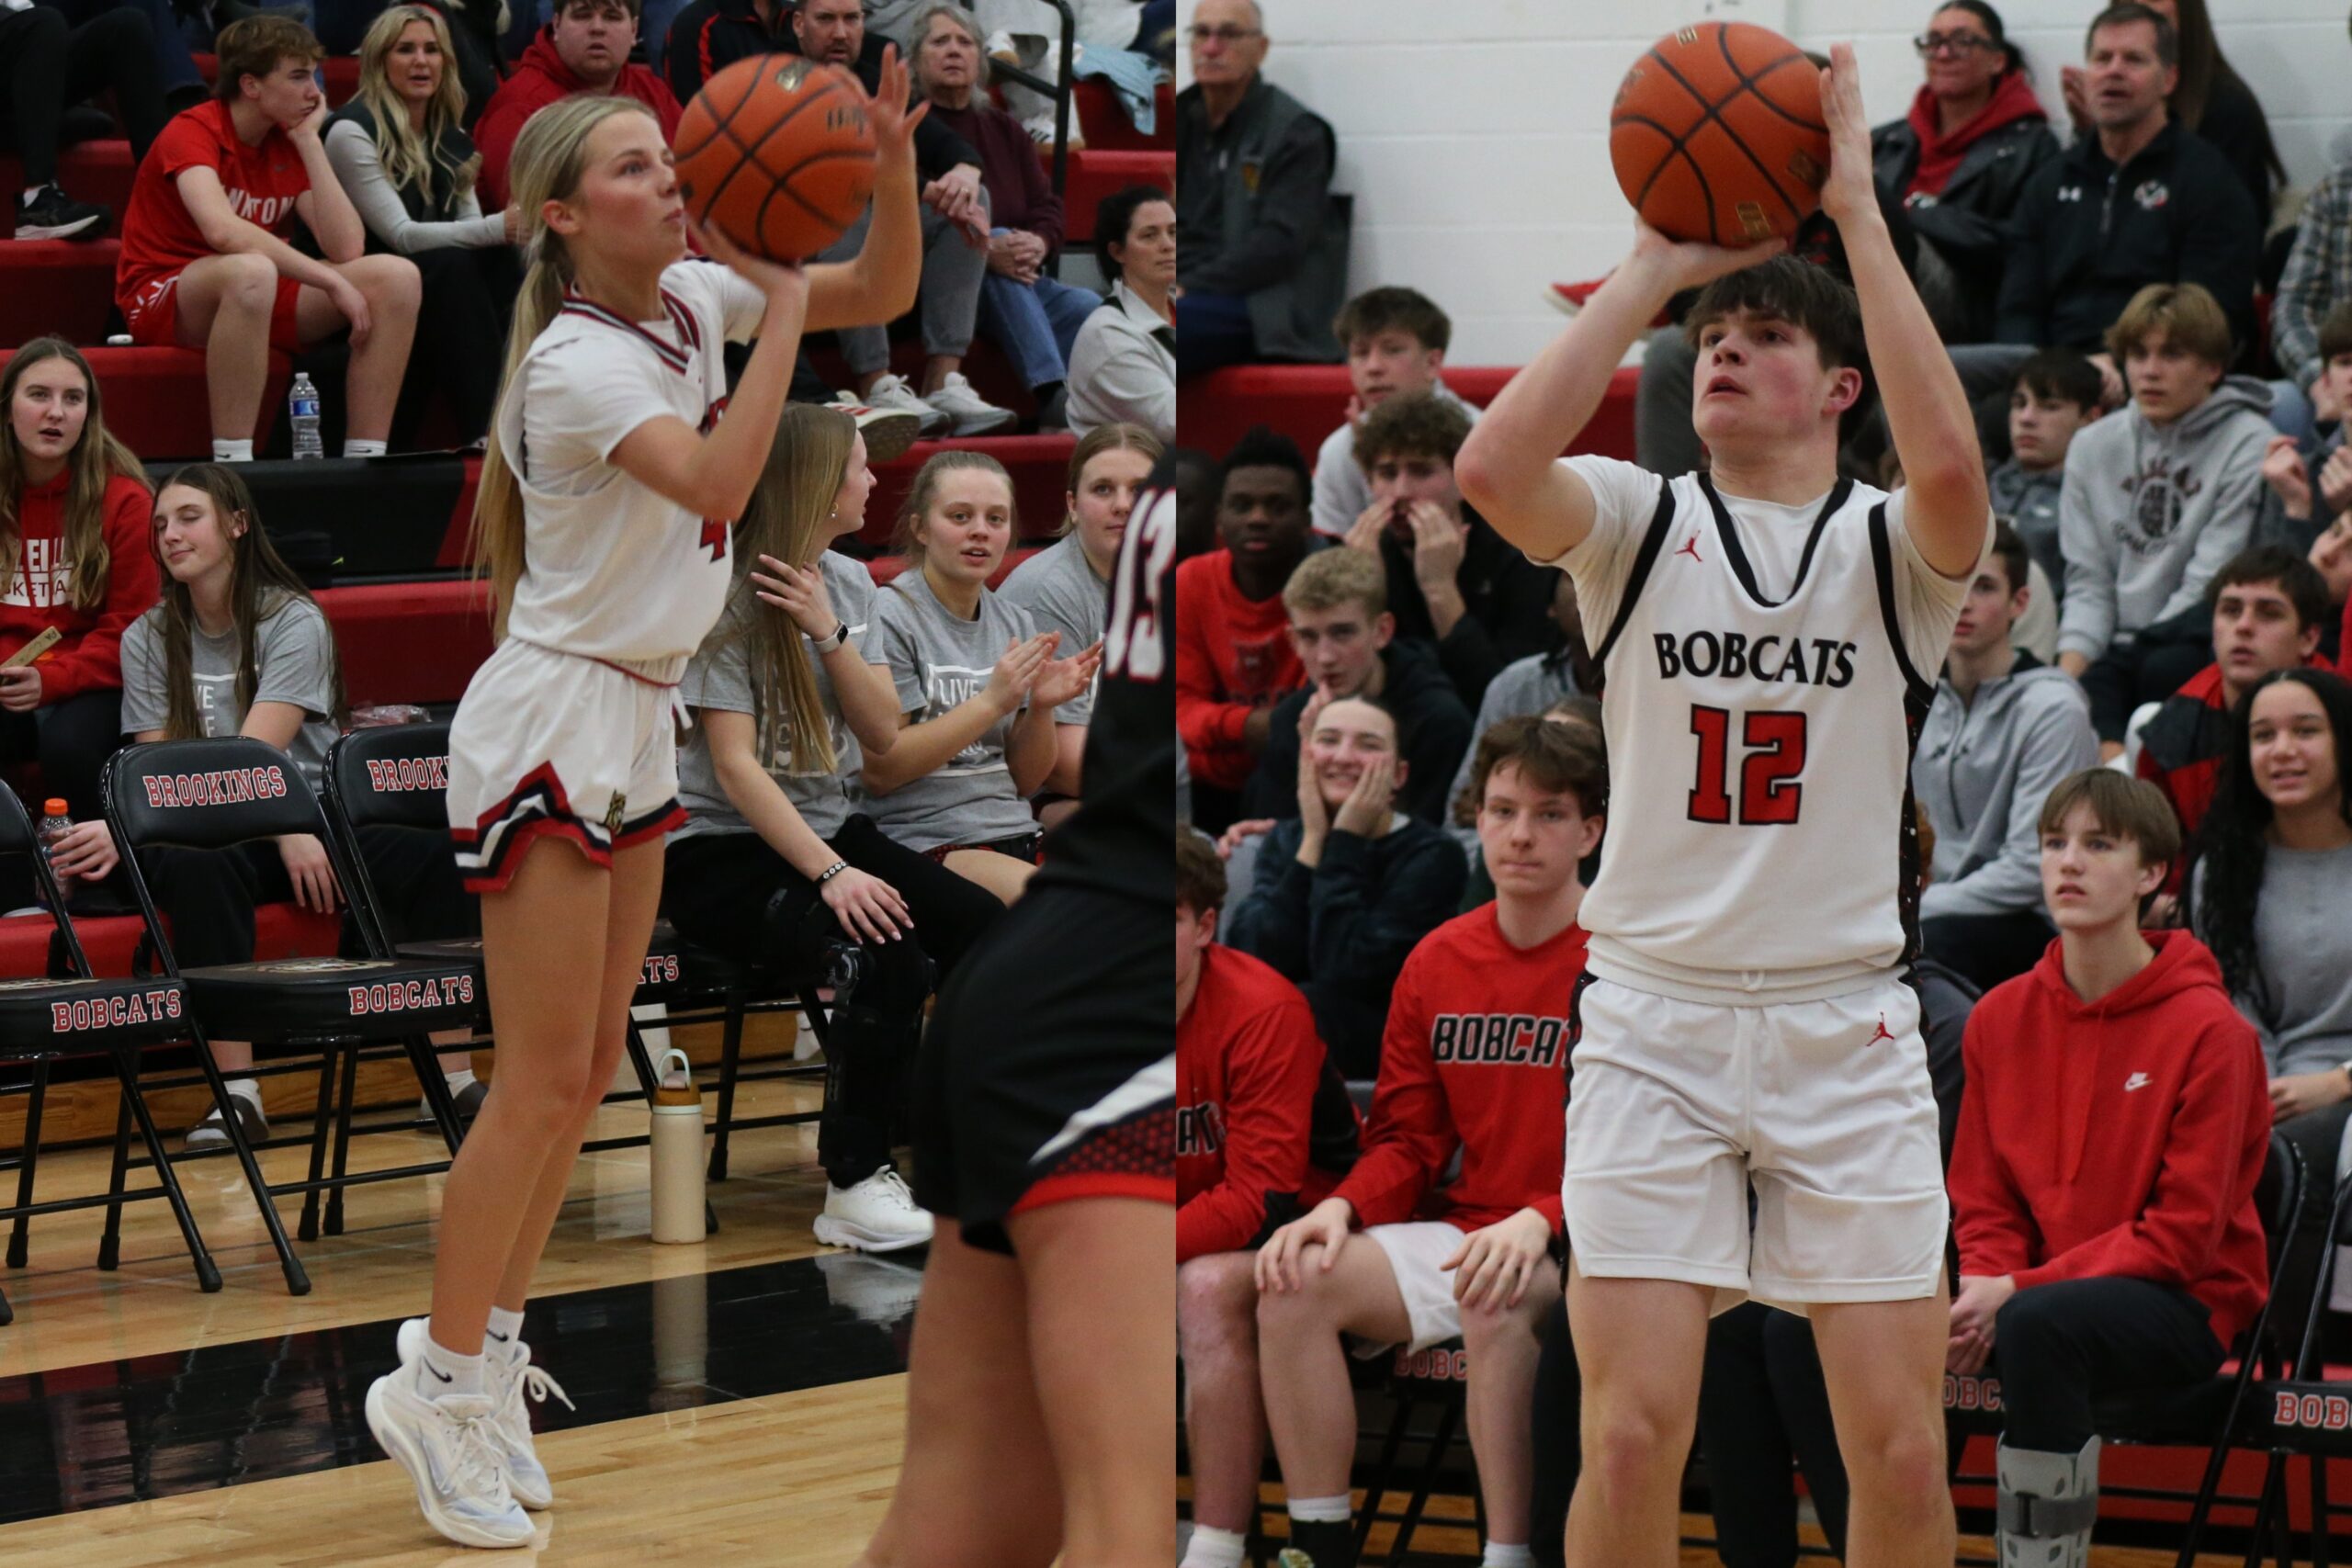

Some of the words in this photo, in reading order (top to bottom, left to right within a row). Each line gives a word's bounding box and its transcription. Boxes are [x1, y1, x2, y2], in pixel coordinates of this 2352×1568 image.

[1103, 485, 1176, 681] 13
[1653, 630, 1857, 688] BOBCATS
[1687, 703, 1807, 826] 12
[142, 765, 288, 808] BROOKINGS
[51, 989, 182, 1032] BOBCATS
[349, 975, 474, 1015] BOBCATS
[2274, 1391, 2352, 1429] BOB
